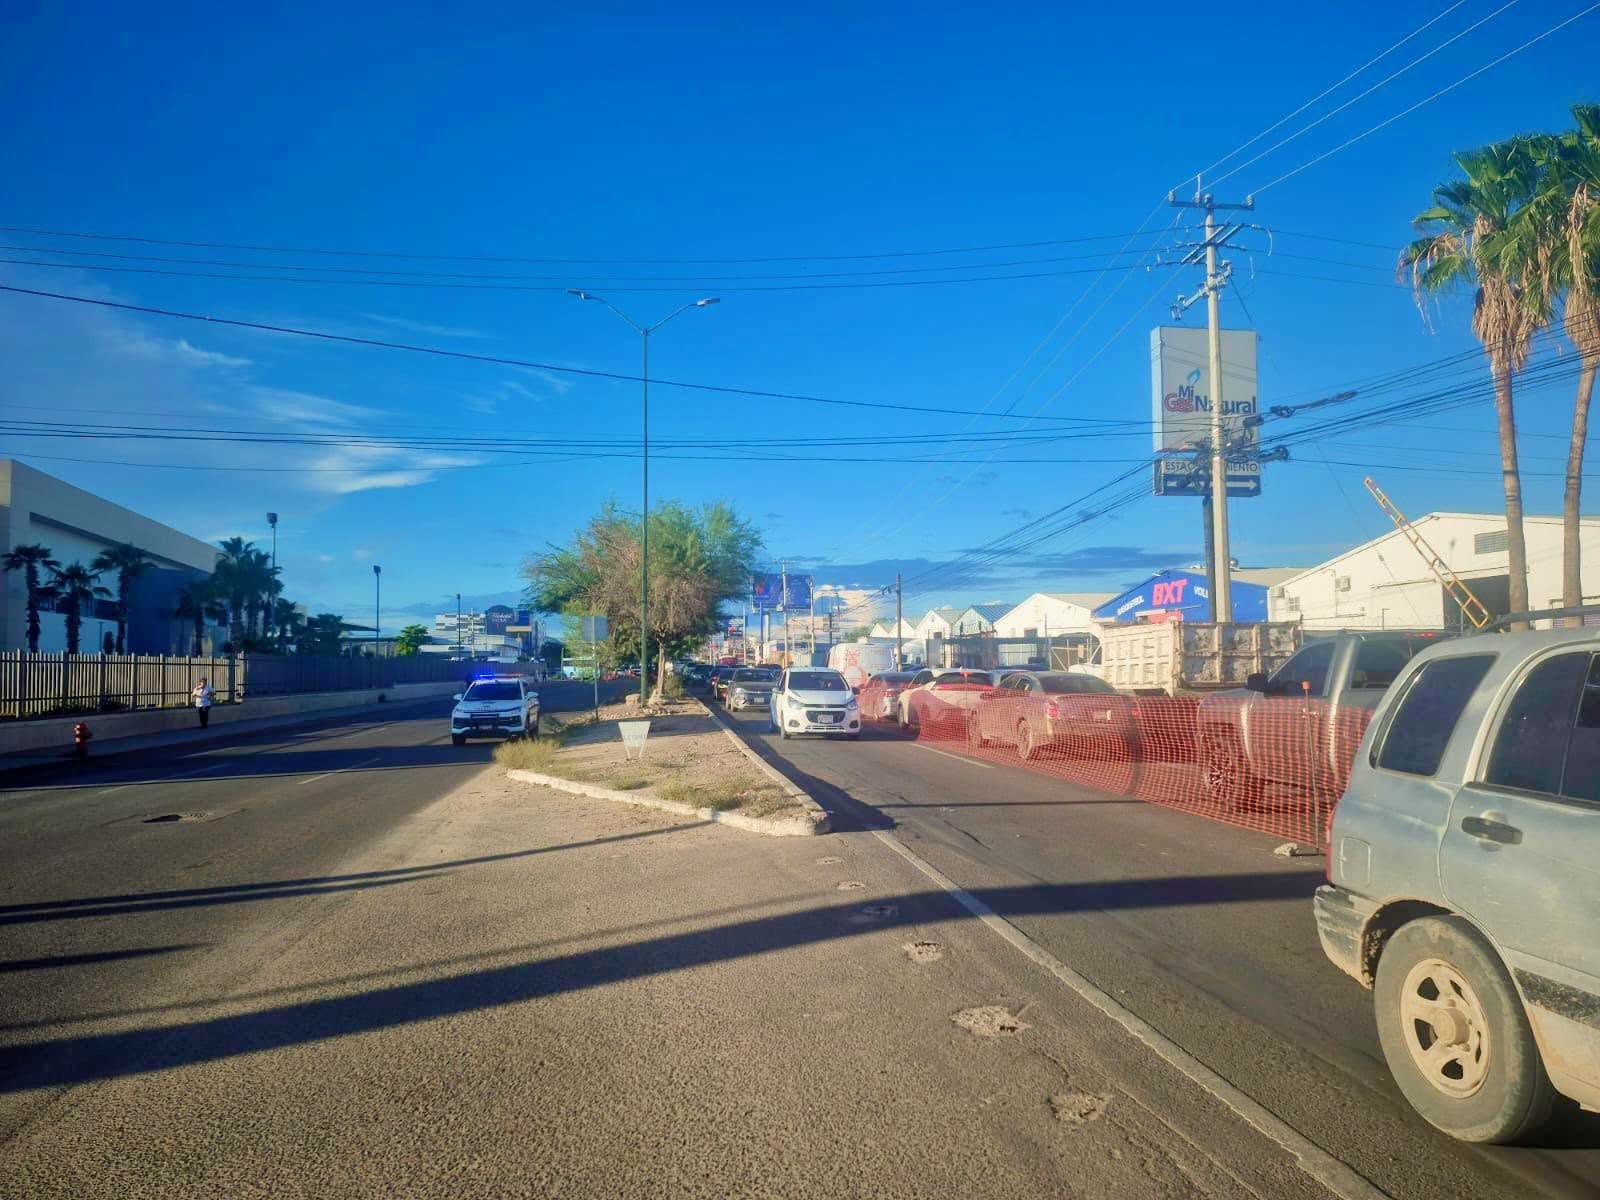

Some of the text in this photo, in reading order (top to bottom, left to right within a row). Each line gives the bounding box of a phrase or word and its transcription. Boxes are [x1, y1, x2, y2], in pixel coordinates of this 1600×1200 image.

[1178, 385, 1194, 399] Mi
[1164, 393, 1194, 412] Gas
[1152, 579, 1188, 606] BXT
